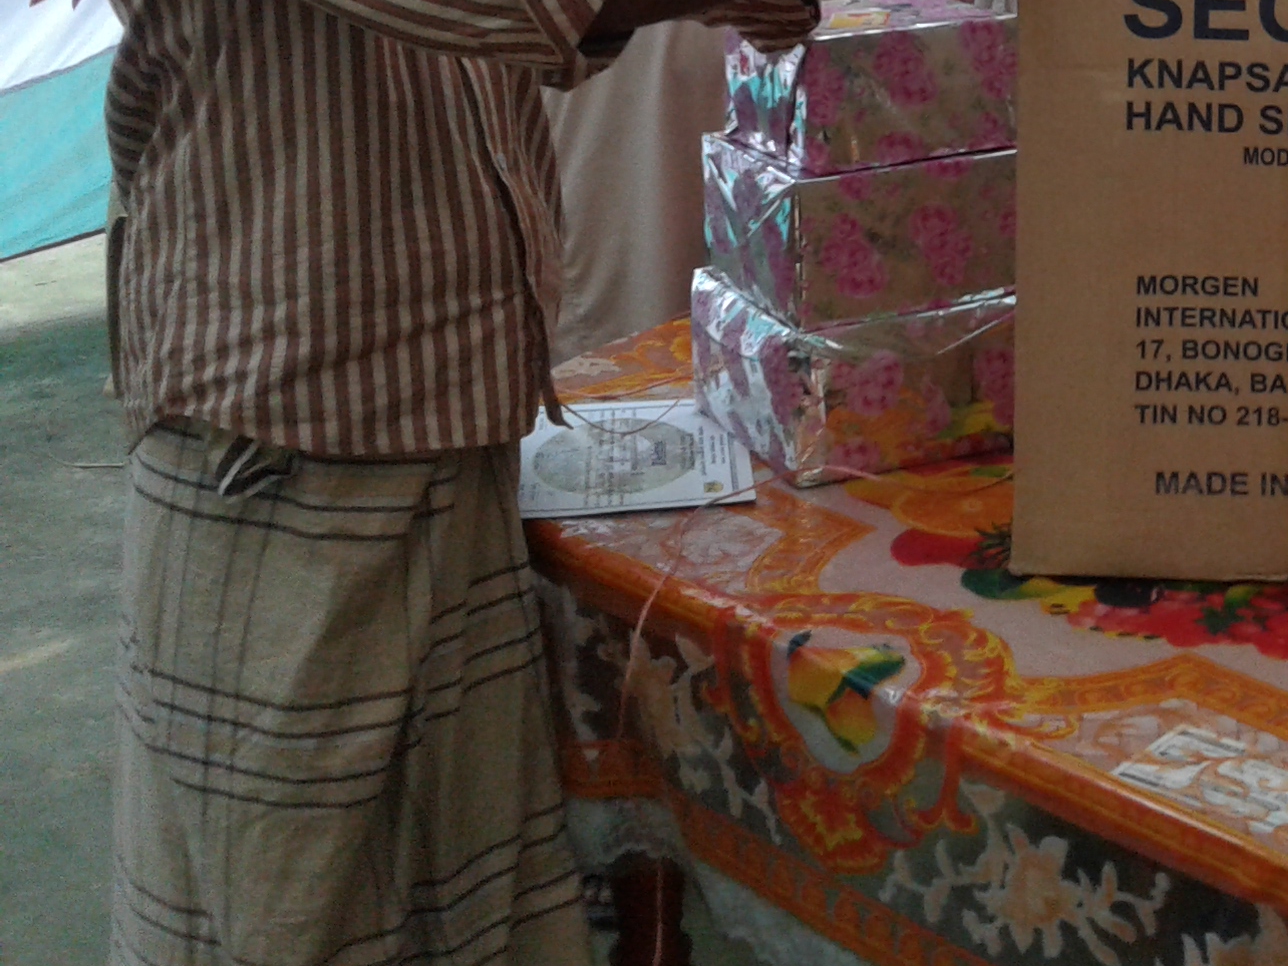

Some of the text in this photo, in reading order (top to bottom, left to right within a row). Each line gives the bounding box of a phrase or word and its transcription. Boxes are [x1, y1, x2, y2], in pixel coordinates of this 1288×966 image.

[1125, 101, 1244, 133] HAND
[1136, 275, 1259, 298] MORGEN
[1136, 340, 1172, 363] 17,
[1135, 371, 1240, 395] DHAKA,
[1135, 405, 1177, 425] TIN
[1187, 406, 1227, 426] NO
[1155, 471, 1249, 496] MADE
